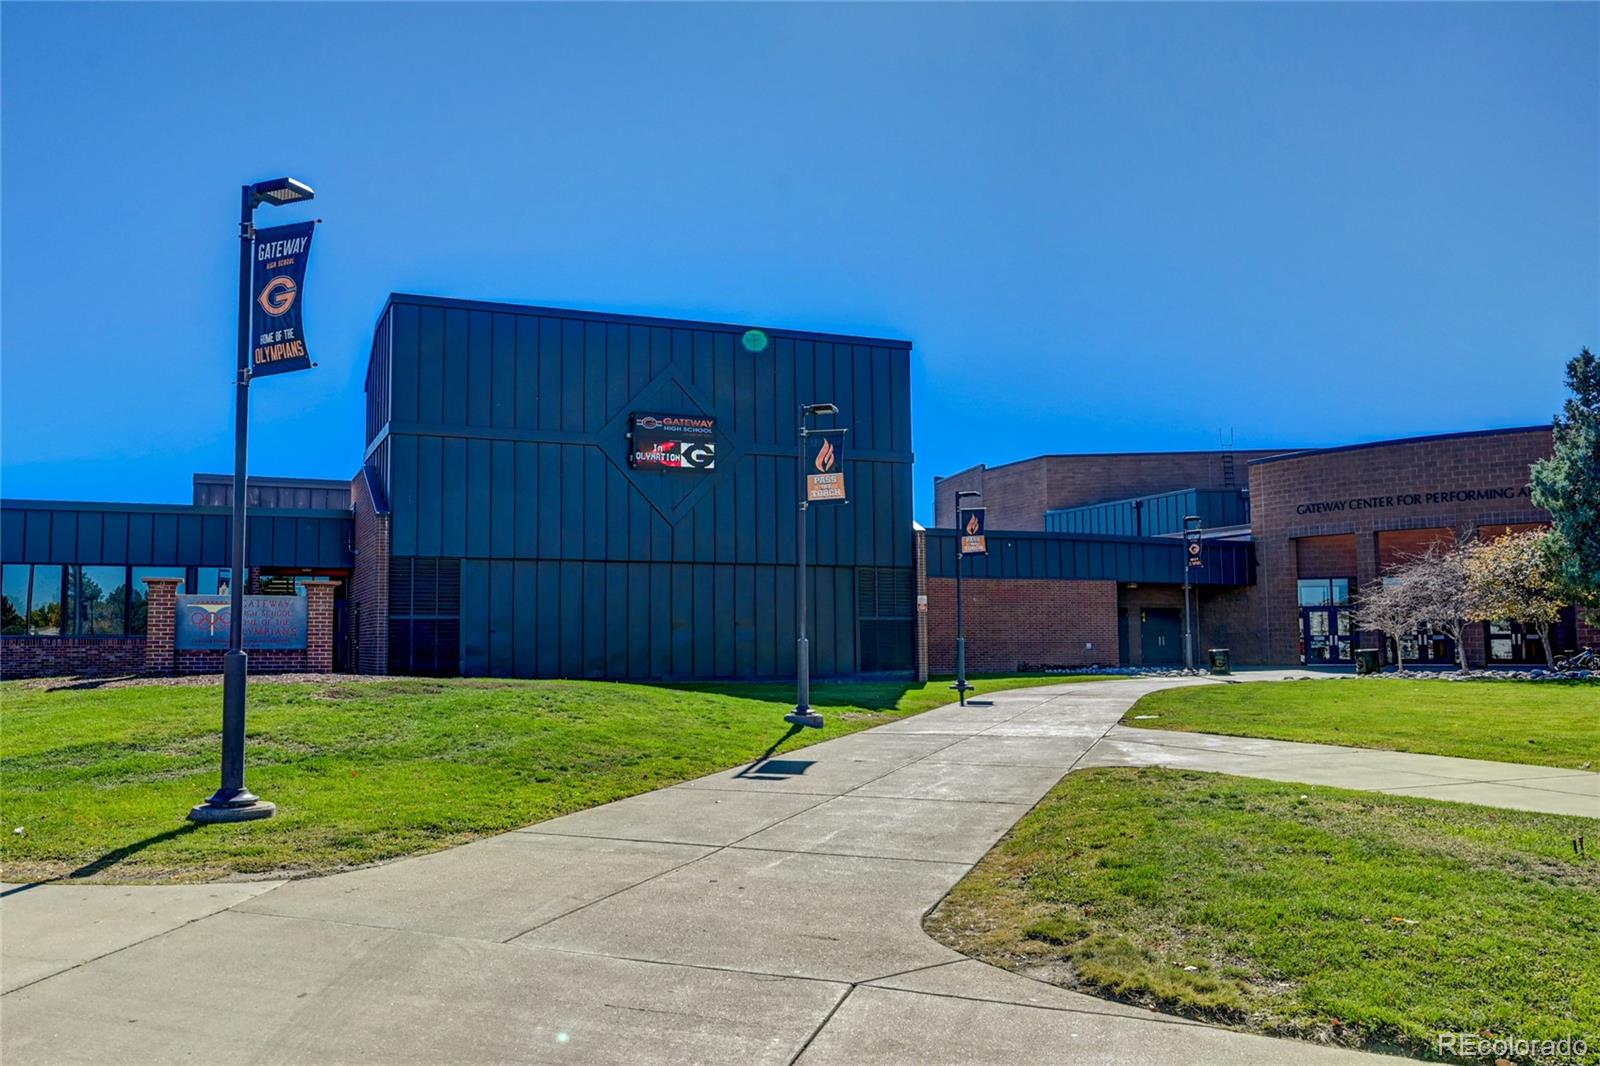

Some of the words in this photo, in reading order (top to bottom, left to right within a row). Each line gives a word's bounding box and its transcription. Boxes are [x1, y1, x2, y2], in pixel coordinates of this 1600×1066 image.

[258, 236, 308, 261] GATEWAY
[278, 257, 295, 267] SCHOOL
[260, 331, 275, 345] HOME
[275, 330, 282, 341] OF
[283, 327, 295, 340] THE
[255, 340, 304, 364] OLYMPIANS
[663, 417, 714, 428] GATEWAY
[683, 426, 713, 434] SCHOOL
[814, 475, 837, 484] PASS
[811, 488, 841, 497] TORCH
[1296, 500, 1347, 515] GATEWAY
[1349, 496, 1394, 511] CENTER
[1396, 494, 1422, 507] FOR
[1425, 487, 1515, 504] PERFORMING
[244, 627, 297, 636] LYMPIANS
